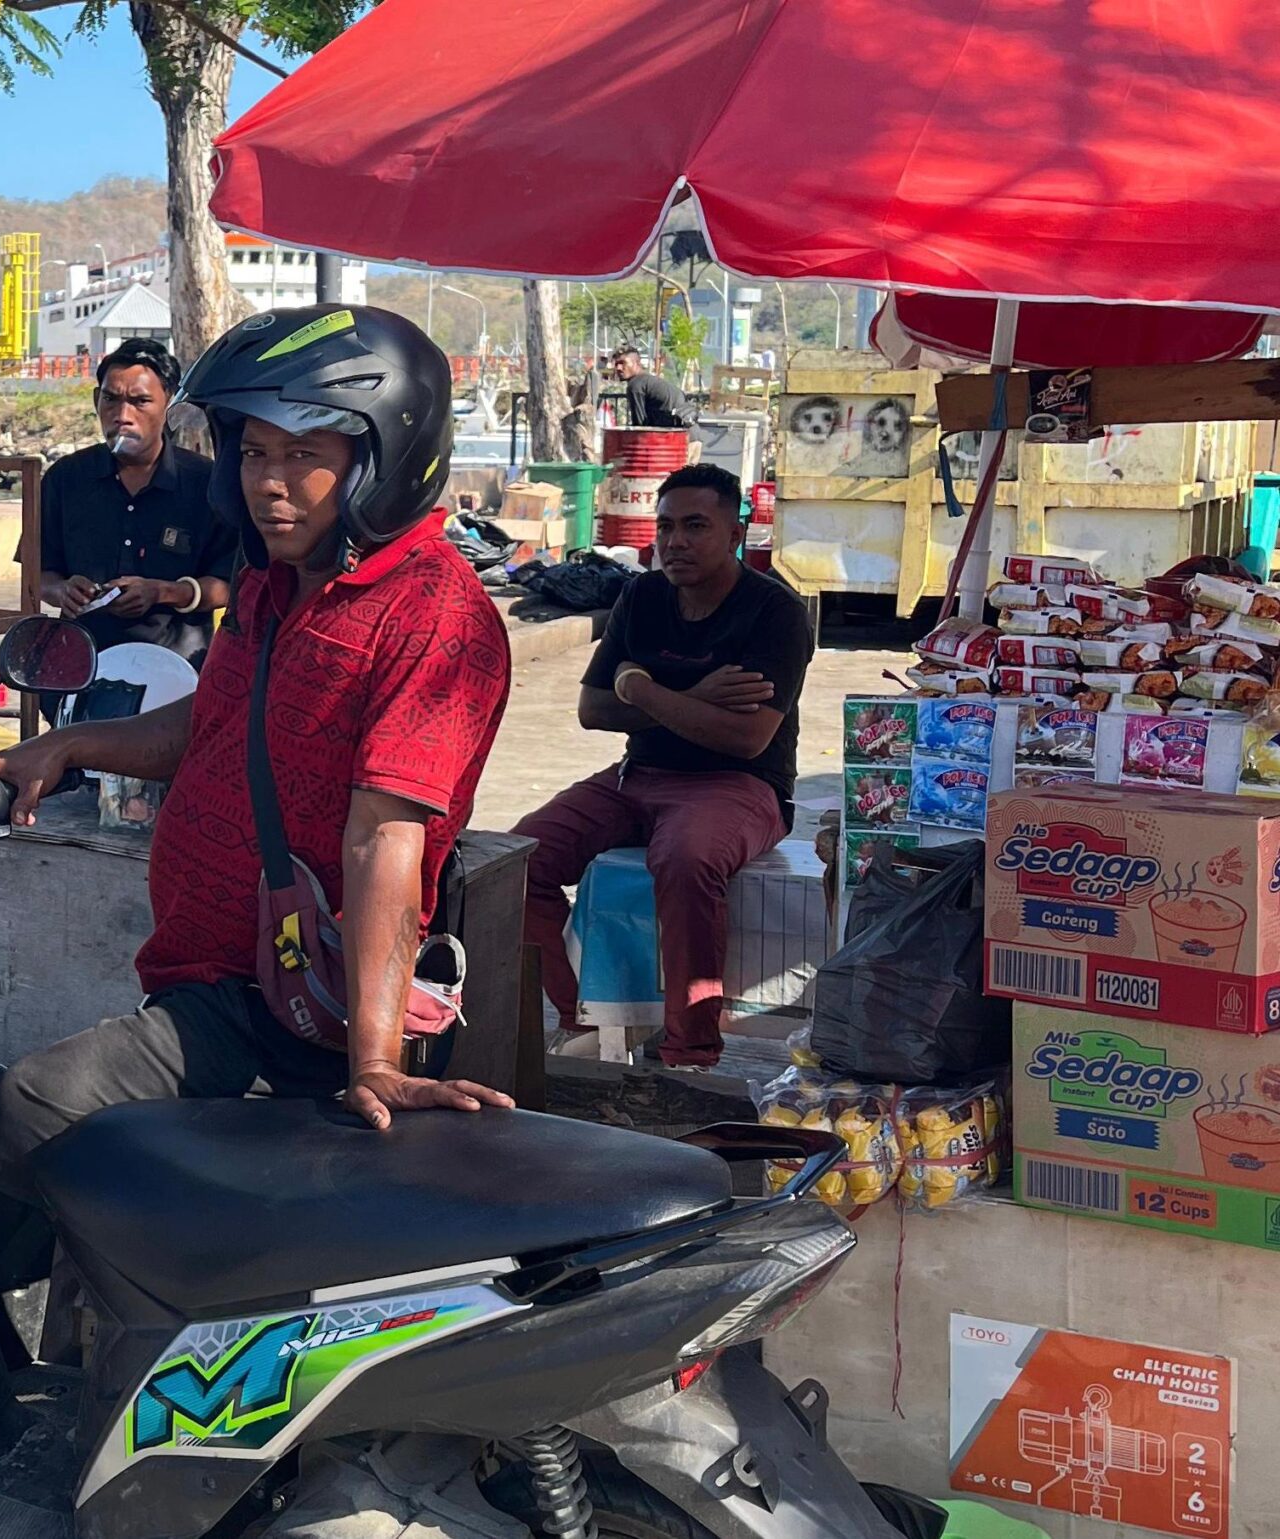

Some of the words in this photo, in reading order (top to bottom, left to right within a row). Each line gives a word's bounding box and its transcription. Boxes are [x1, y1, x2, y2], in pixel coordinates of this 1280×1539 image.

[610, 490, 655, 504] PERT
[1013, 823, 1048, 838] Mie
[995, 838, 1160, 892] Sedaap
[1073, 879, 1118, 900] Cup
[1041, 911, 1098, 933] Goreng
[1097, 973, 1158, 1007] 1120081
[1045, 1031, 1081, 1046] Mie
[1028, 1046, 1201, 1102] Sedaap
[1109, 1088, 1157, 1111] Cup
[1087, 1122, 1126, 1140] Soto
[1134, 1192, 1166, 1213] 12
[1170, 1200, 1210, 1220] Cups
[379, 1308, 438, 1331] 125
[968, 1327, 1005, 1342] TOYO
[1143, 1358, 1219, 1380] ELECTRIC
[1112, 1367, 1164, 1386] CHAIN
[1169, 1377, 1219, 1395] HOIST
[1182, 1396, 1215, 1408] Series
[1188, 1442, 1206, 1465] 2
[1188, 1467, 1206, 1476] TON
[1188, 1491, 1205, 1512] 6
[1181, 1513, 1211, 1525] METER
